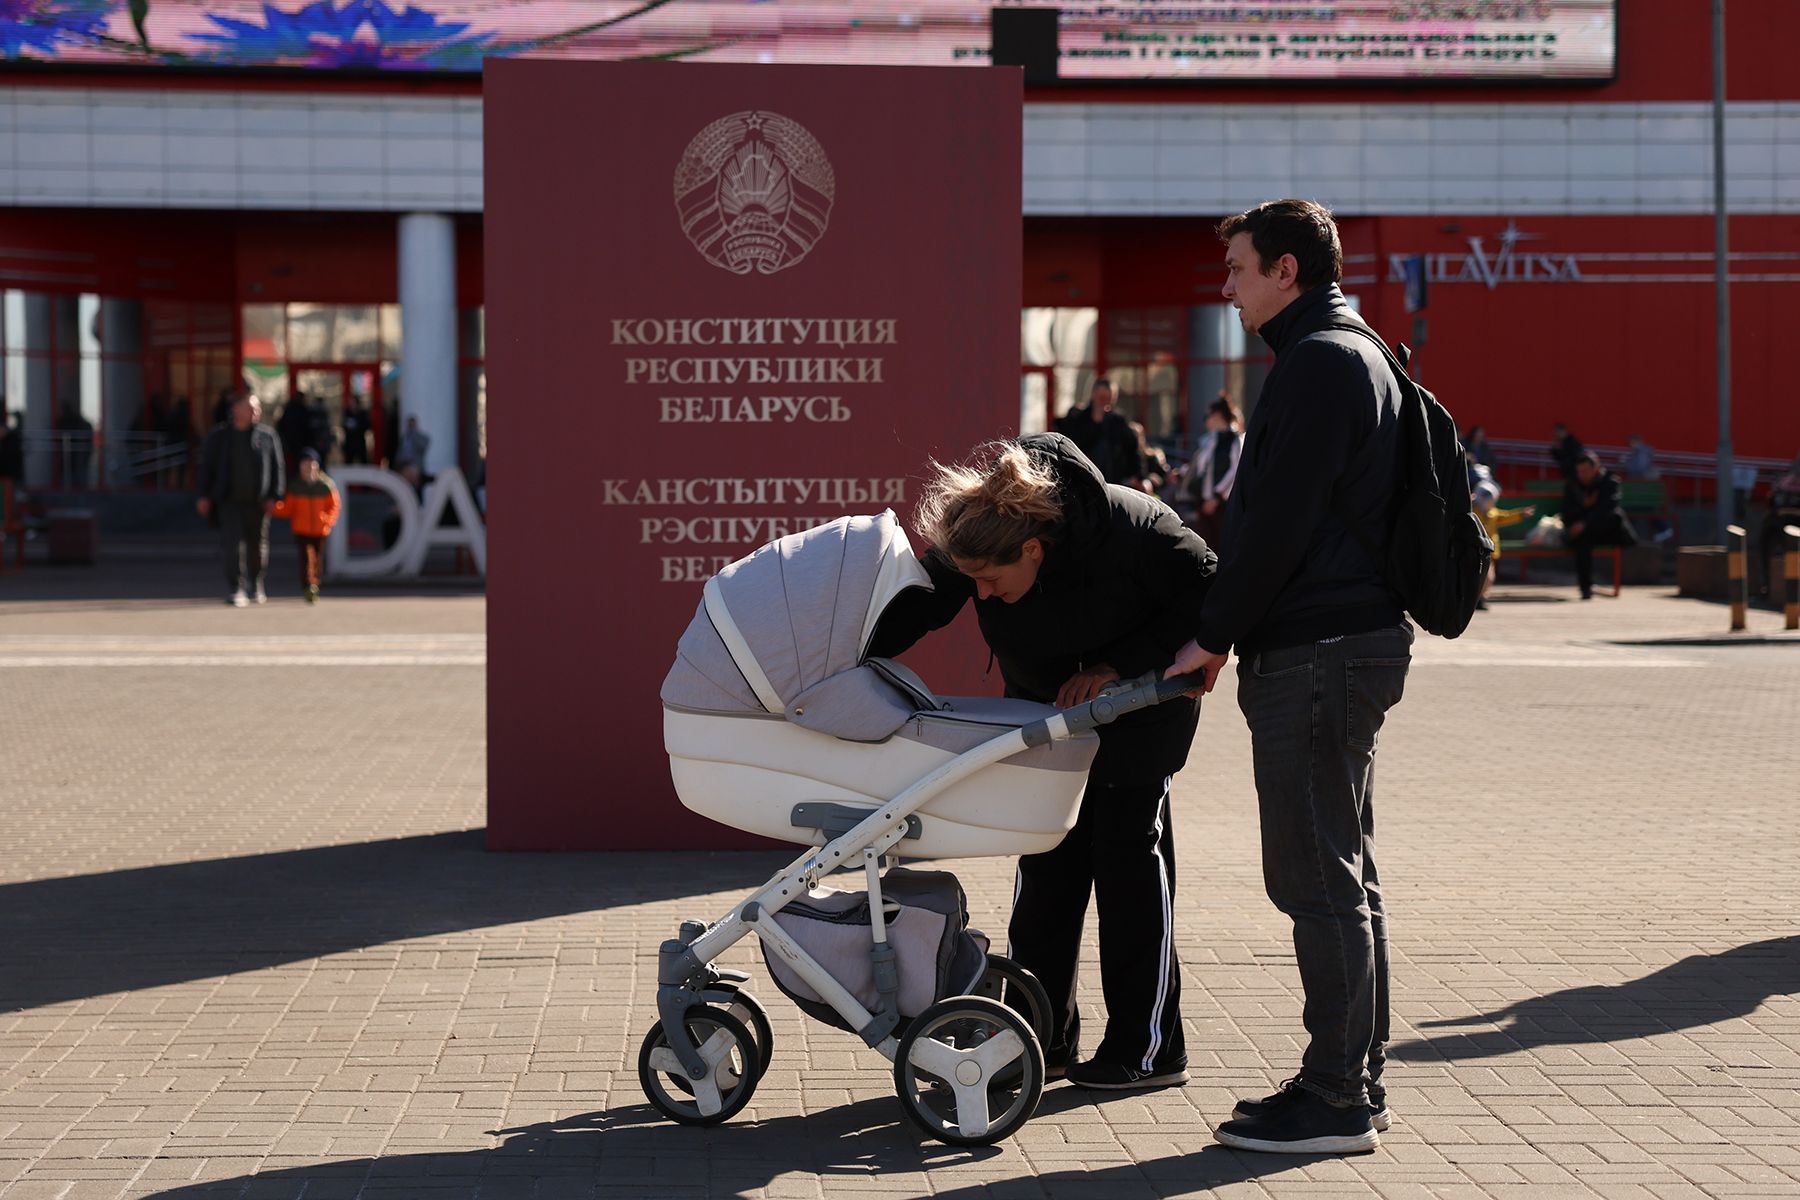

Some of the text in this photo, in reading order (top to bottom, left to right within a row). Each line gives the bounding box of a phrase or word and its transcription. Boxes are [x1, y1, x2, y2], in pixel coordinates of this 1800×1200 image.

[609, 318, 898, 349] КОНСТИТУЦИЯ
[624, 357, 884, 385] РЕСПУБЛИКИ
[658, 396, 852, 423] БЕЛАРУСЬ
[602, 478, 907, 508] КАНСТЫТУЦЫЯ
[639, 517, 830, 544] РЭСПУБЛ
[660, 556, 733, 582] БЕЛ
